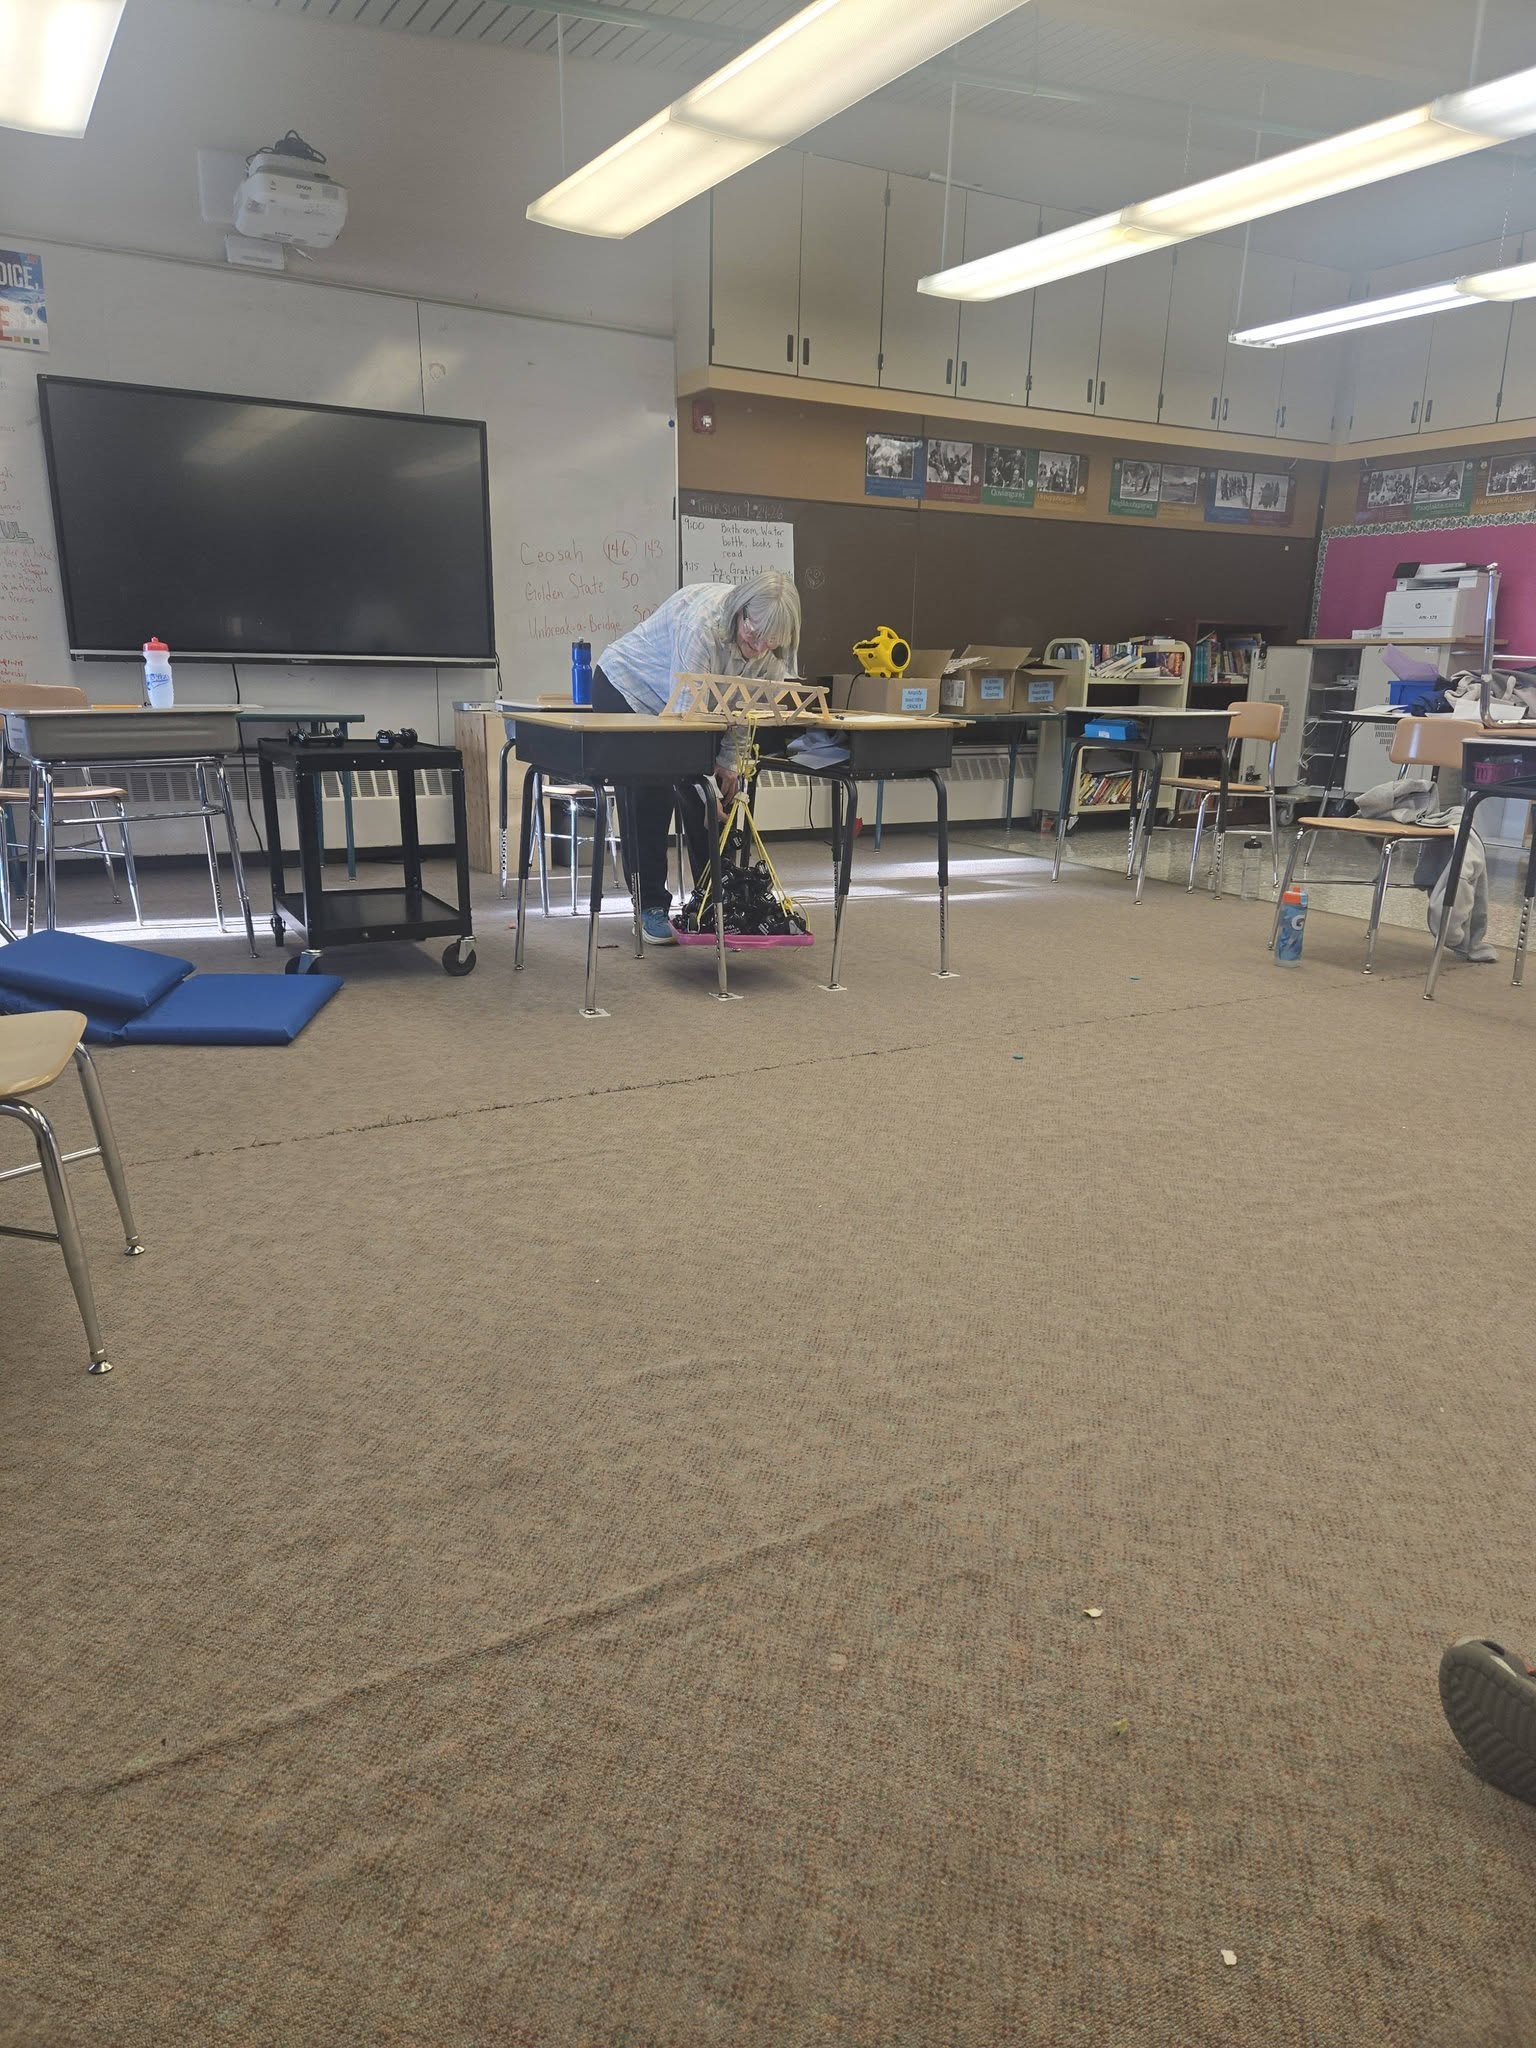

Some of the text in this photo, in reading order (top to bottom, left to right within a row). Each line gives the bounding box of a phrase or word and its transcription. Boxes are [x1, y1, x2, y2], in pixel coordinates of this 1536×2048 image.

[684, 518, 705, 531] 9:00
[760, 523, 785, 536] Water
[606, 538, 630, 561] 146
[644, 539, 664, 559] 143
[722, 549, 743, 559] read
[684, 560, 700, 572] 9:15
[525, 571, 640, 602] Golden State 50
[1291, 914, 1306, 931] G
